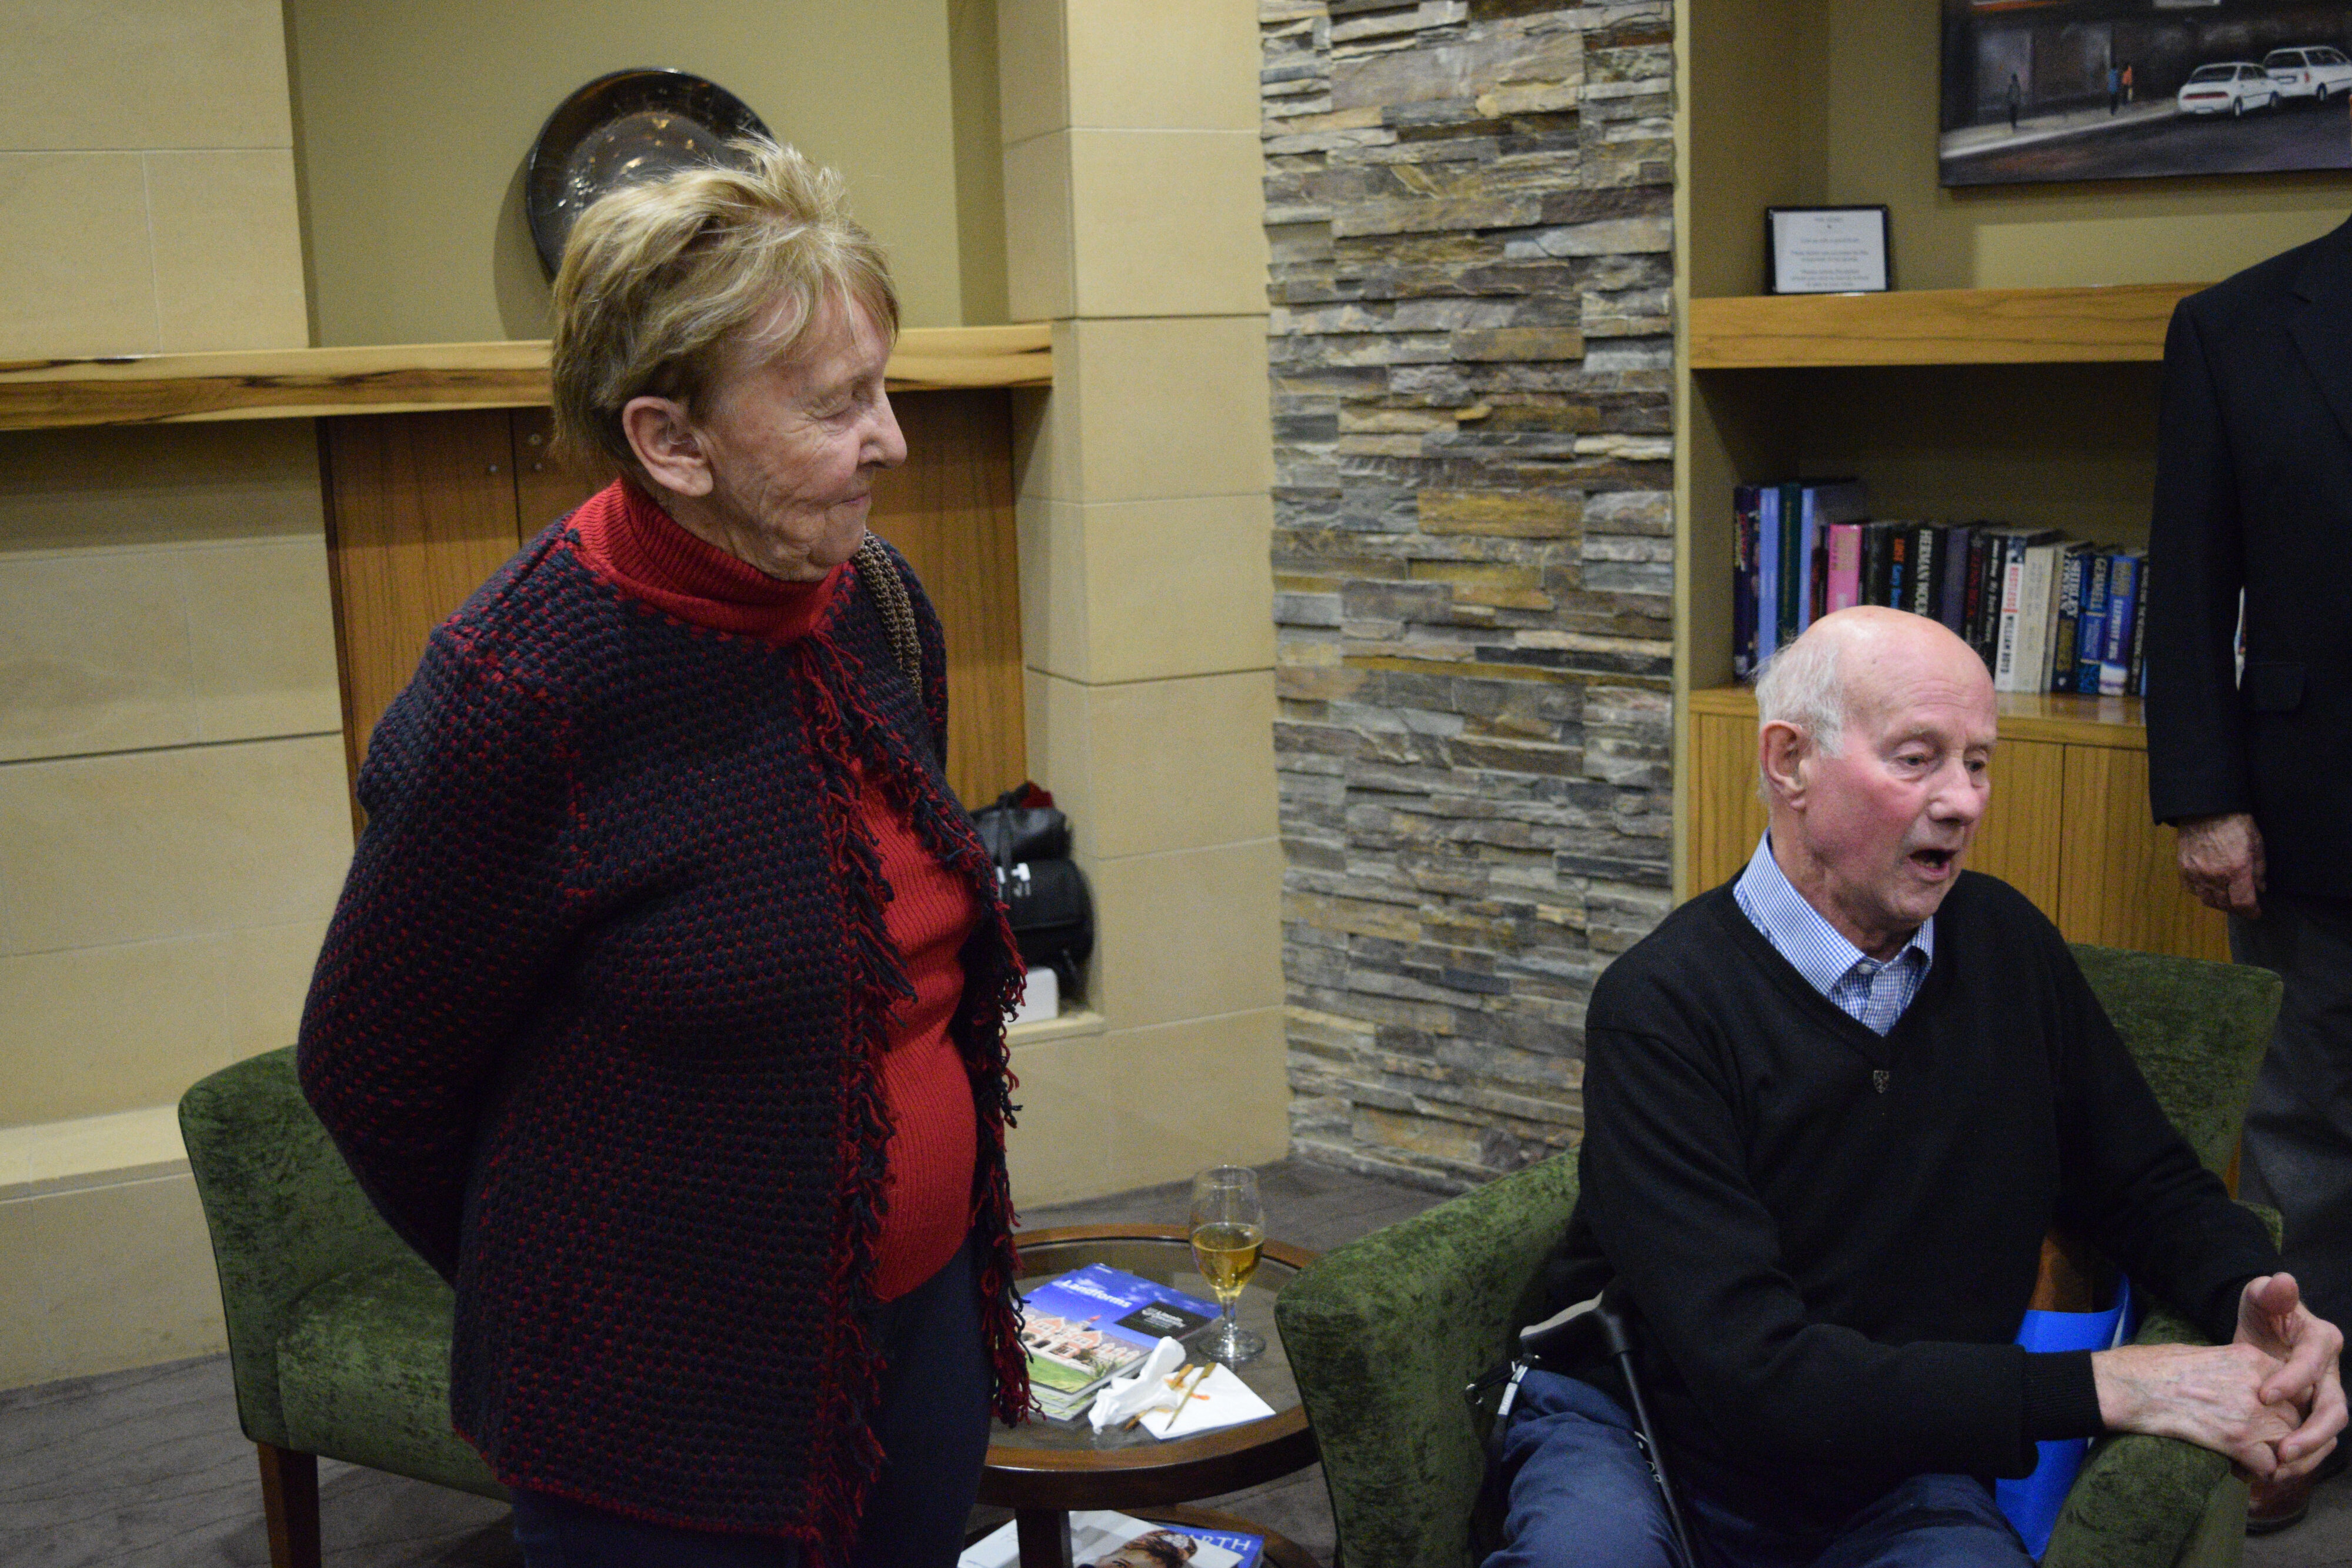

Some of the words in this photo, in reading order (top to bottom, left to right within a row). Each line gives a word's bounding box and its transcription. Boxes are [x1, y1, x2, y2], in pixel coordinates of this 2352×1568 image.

[1919, 529, 1933, 579] HERMAN
[2003, 615, 2014, 649] WILLIAM
[2001, 653, 2011, 673] BOYD
[1062, 1279, 1133, 1308] Landforms
[1189, 1534, 1251, 1551] RTH
